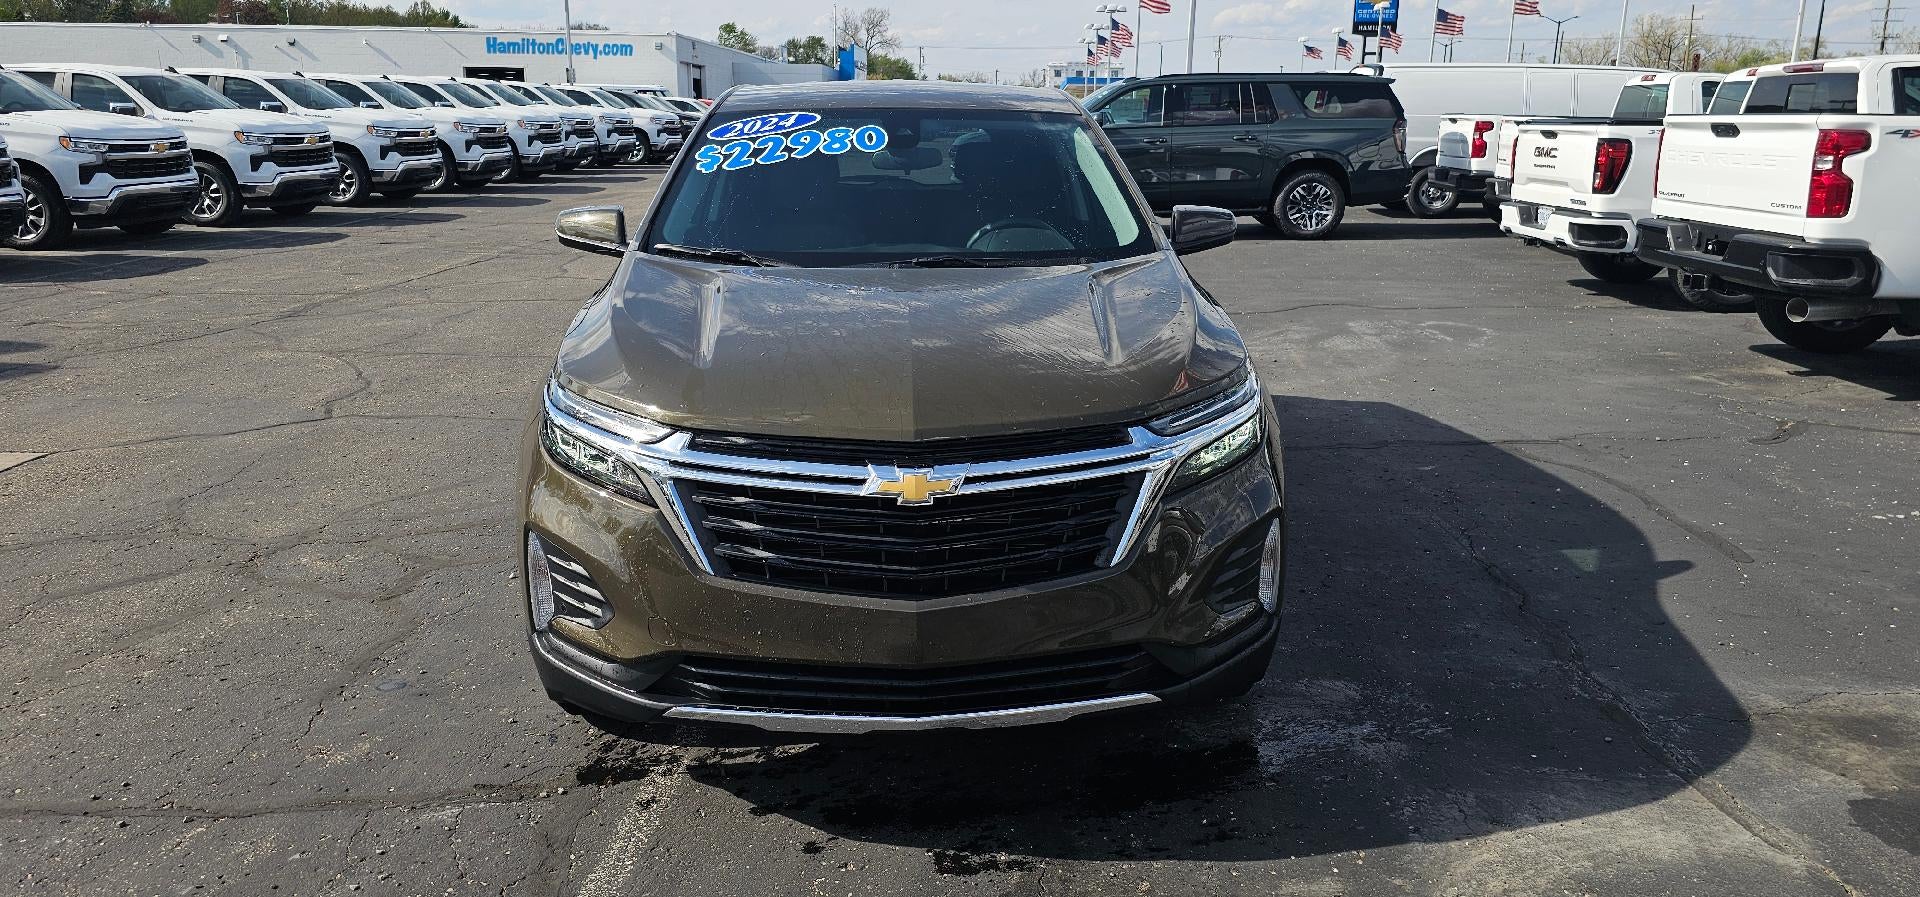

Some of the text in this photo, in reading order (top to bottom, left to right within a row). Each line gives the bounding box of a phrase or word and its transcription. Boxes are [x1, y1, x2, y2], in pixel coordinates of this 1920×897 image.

[723, 113, 799, 137] 2024
[694, 125, 889, 174] $22980
[1533, 146, 1559, 159] GMC
[1665, 148, 1799, 171] CHEVROLET
[1770, 202, 1802, 210] CUSTOM
